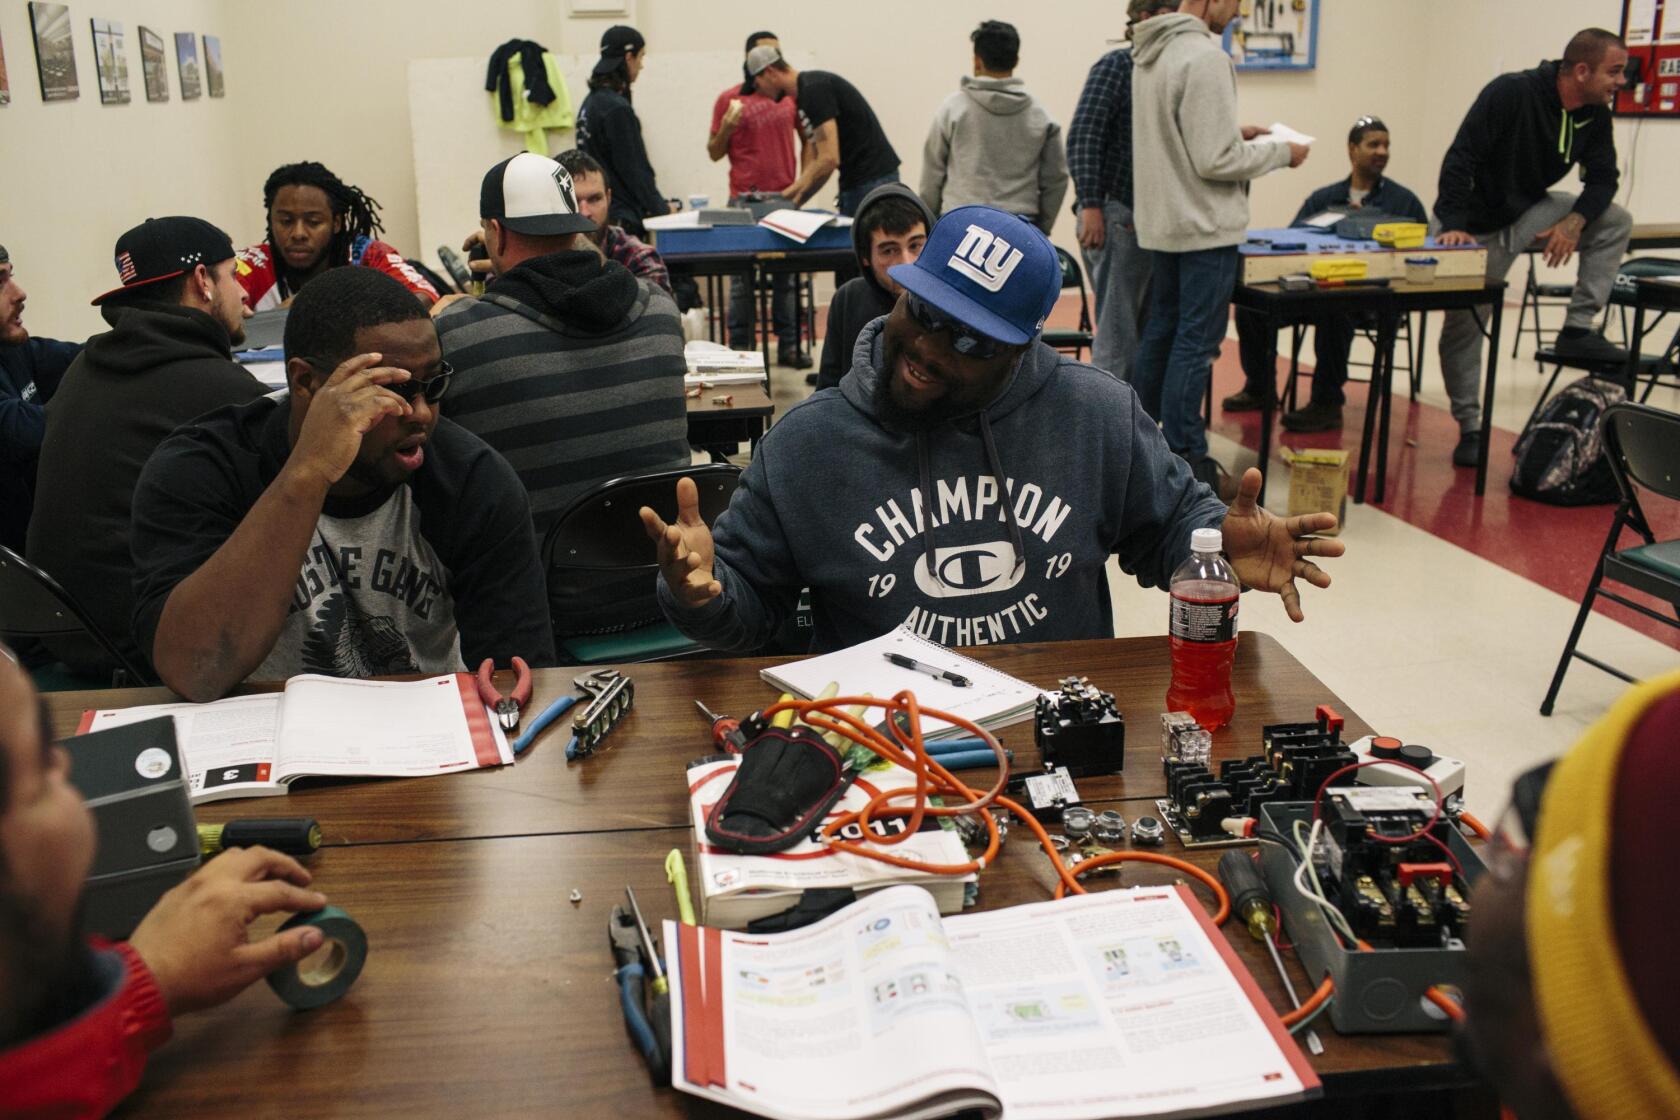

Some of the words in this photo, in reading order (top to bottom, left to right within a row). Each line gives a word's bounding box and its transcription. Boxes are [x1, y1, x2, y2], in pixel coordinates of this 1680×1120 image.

[868, 573, 896, 598] 19
[1045, 552, 1072, 580] 19
[904, 593, 1048, 647] AUTHENTIC
